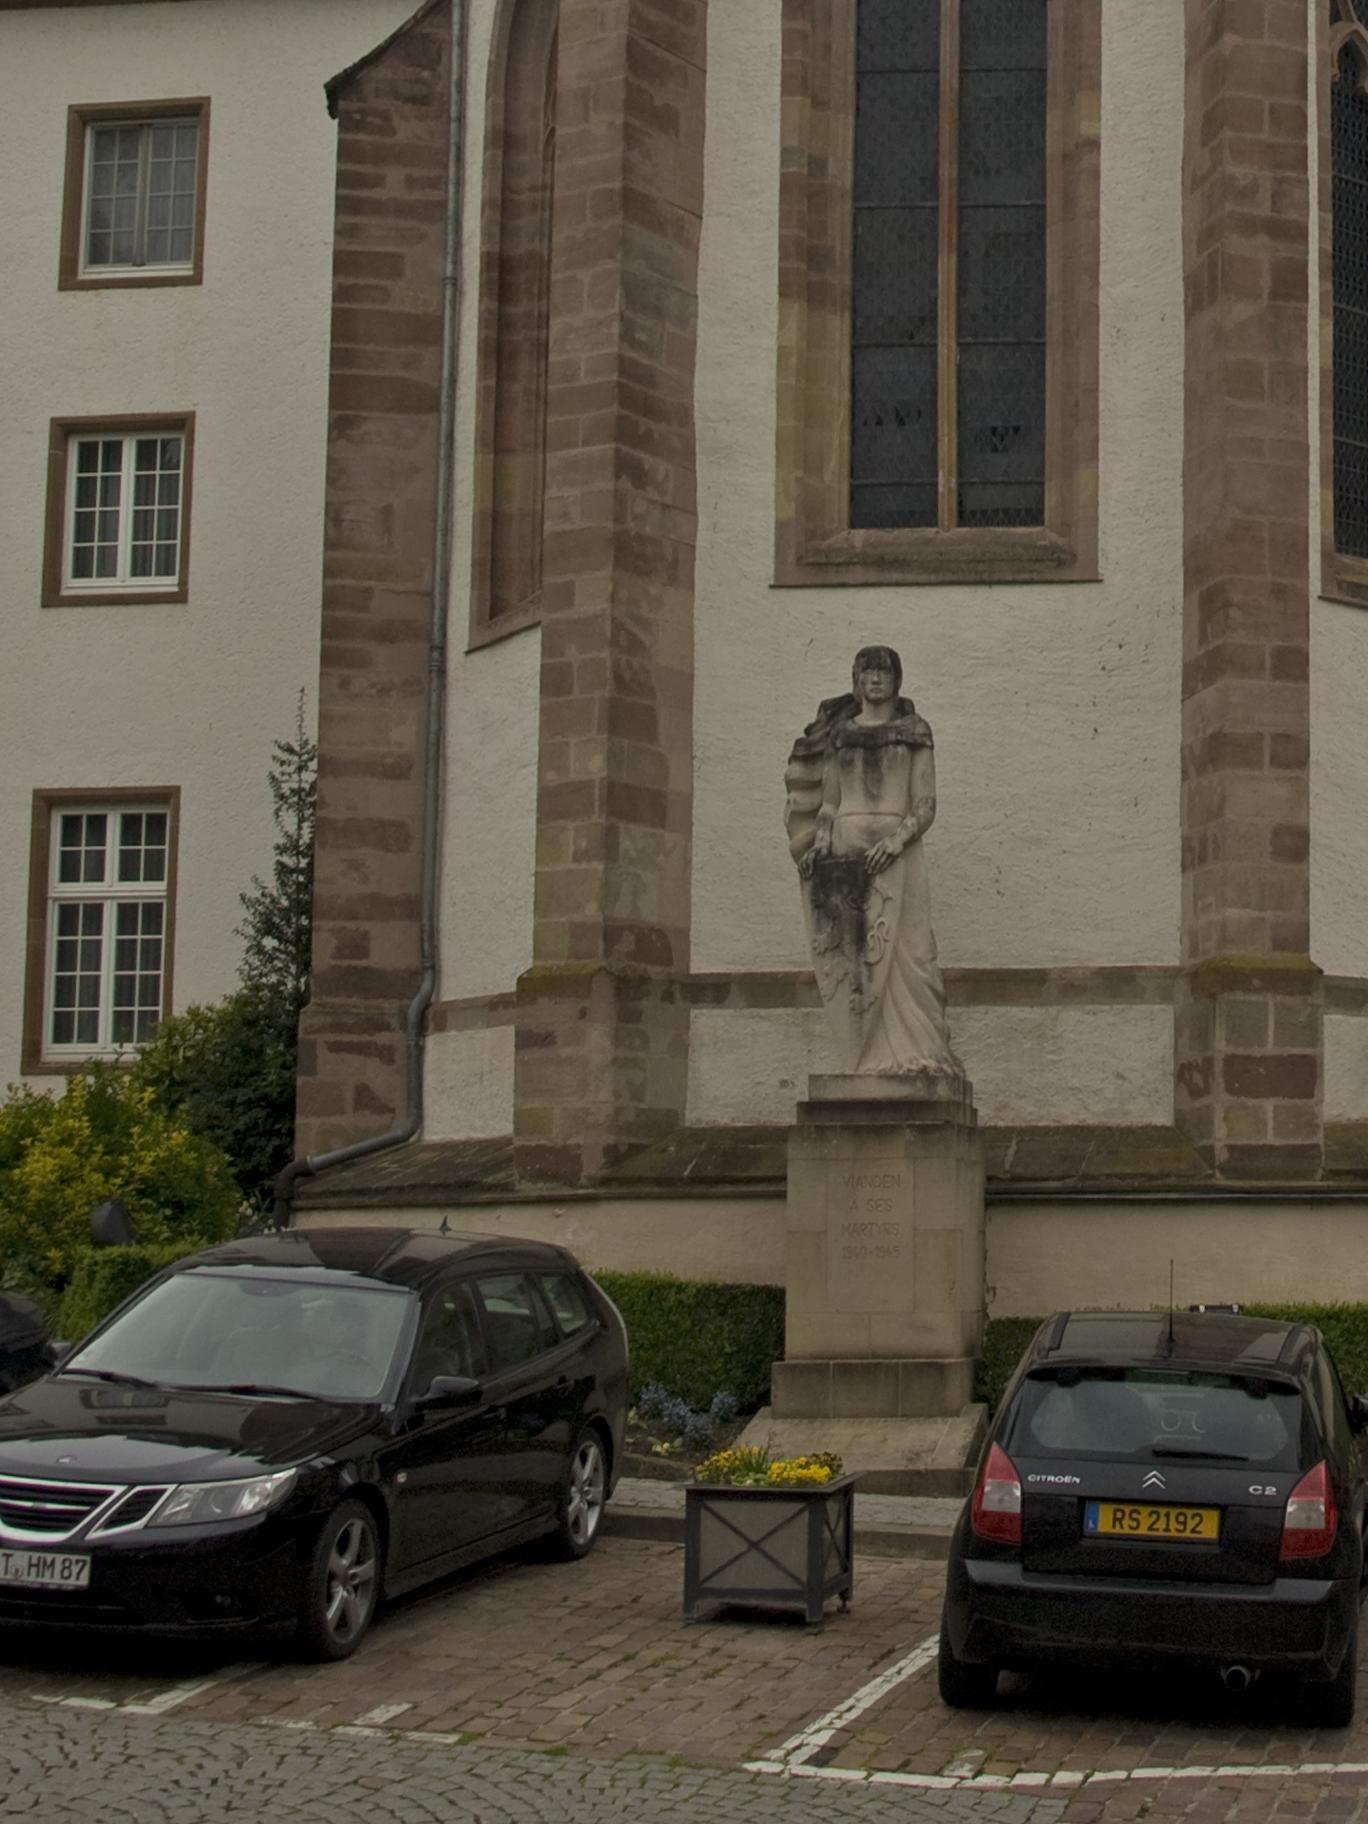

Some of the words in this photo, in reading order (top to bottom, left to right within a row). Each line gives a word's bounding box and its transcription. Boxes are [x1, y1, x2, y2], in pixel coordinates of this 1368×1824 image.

[841, 1174, 902, 1189] VIANDEN
[865, 1198, 893, 1212] SES
[841, 1221, 900, 1237] MARTYRS
[1249, 1485, 1277, 1496] C2
[1111, 1508, 1141, 1531] RS
[1148, 1509, 1204, 1535] 2192
[26, 1555, 57, 1580] HM
[60, 1556, 89, 1582] 87
